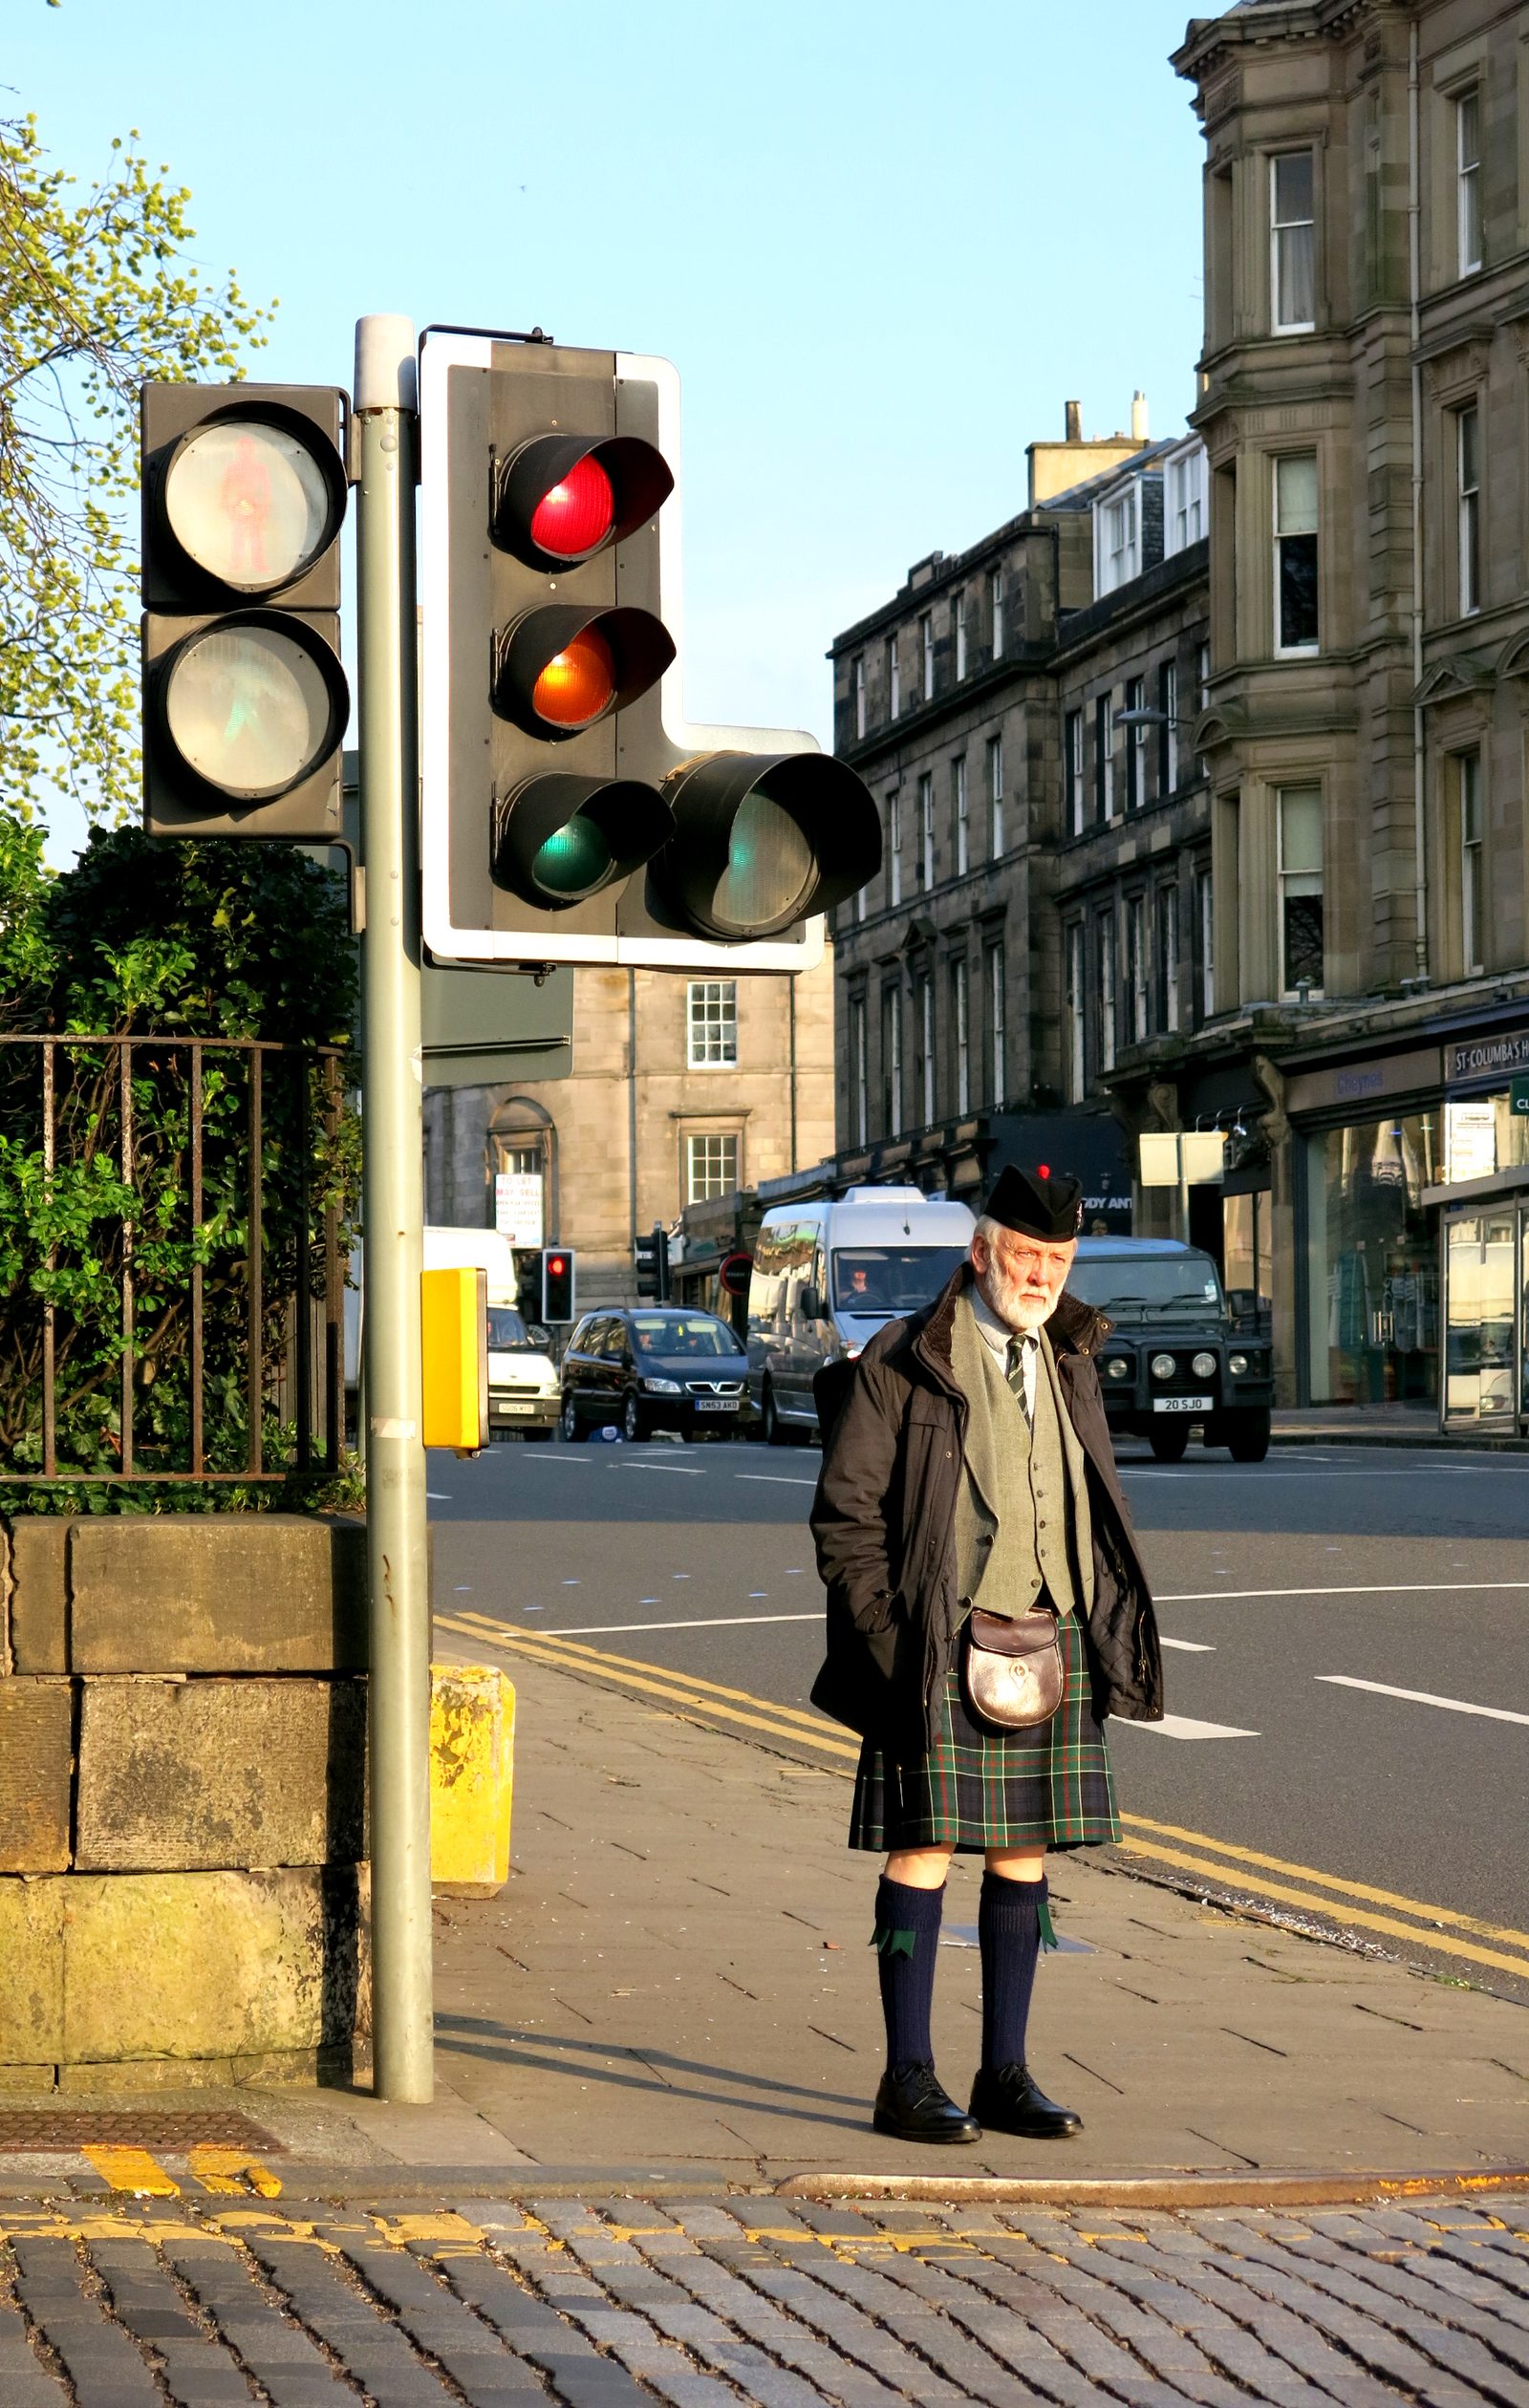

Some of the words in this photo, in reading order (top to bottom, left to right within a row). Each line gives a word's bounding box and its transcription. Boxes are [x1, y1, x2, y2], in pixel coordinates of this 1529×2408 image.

[1470, 1041, 1519, 1068] COLUMBA'S
[502, 1176, 512, 1185] TO
[517, 1176, 531, 1185] LET
[496, 1188, 514, 1196] MAY
[519, 1188, 540, 1197] SELL
[1165, 1399, 1179, 1410] 20
